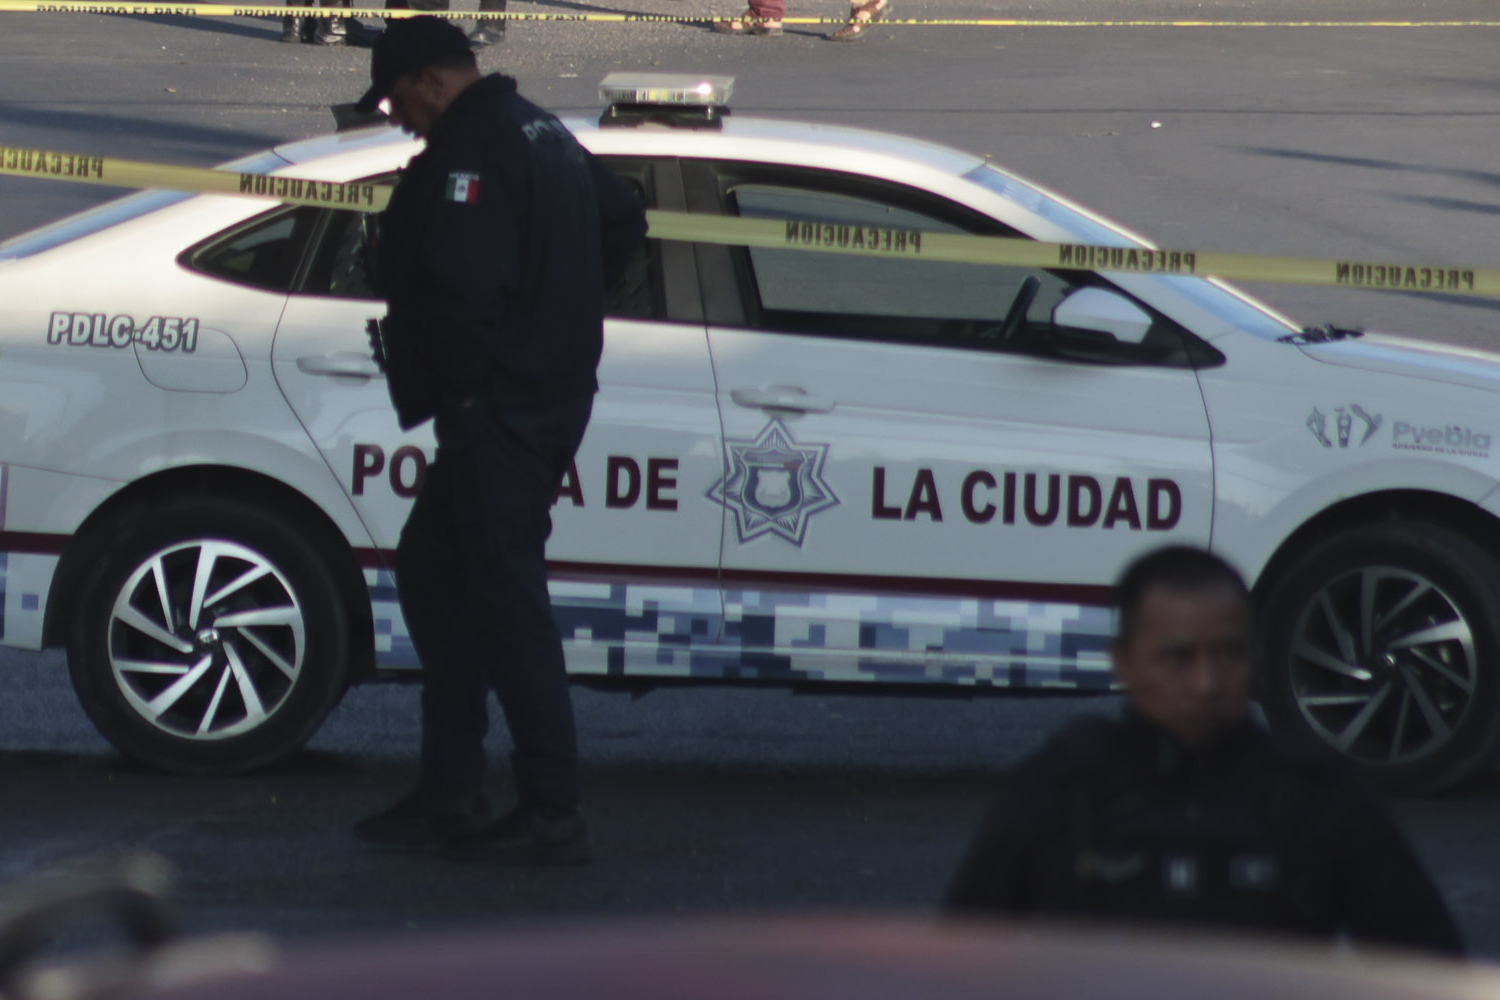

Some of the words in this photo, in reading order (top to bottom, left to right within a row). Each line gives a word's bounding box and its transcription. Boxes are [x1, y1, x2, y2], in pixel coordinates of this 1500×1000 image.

[47, 310, 200, 354] PDLC-451
[606, 455, 680, 511] DE
[872, 464, 944, 524] LA
[961, 468, 1184, 532] CIUDAD
